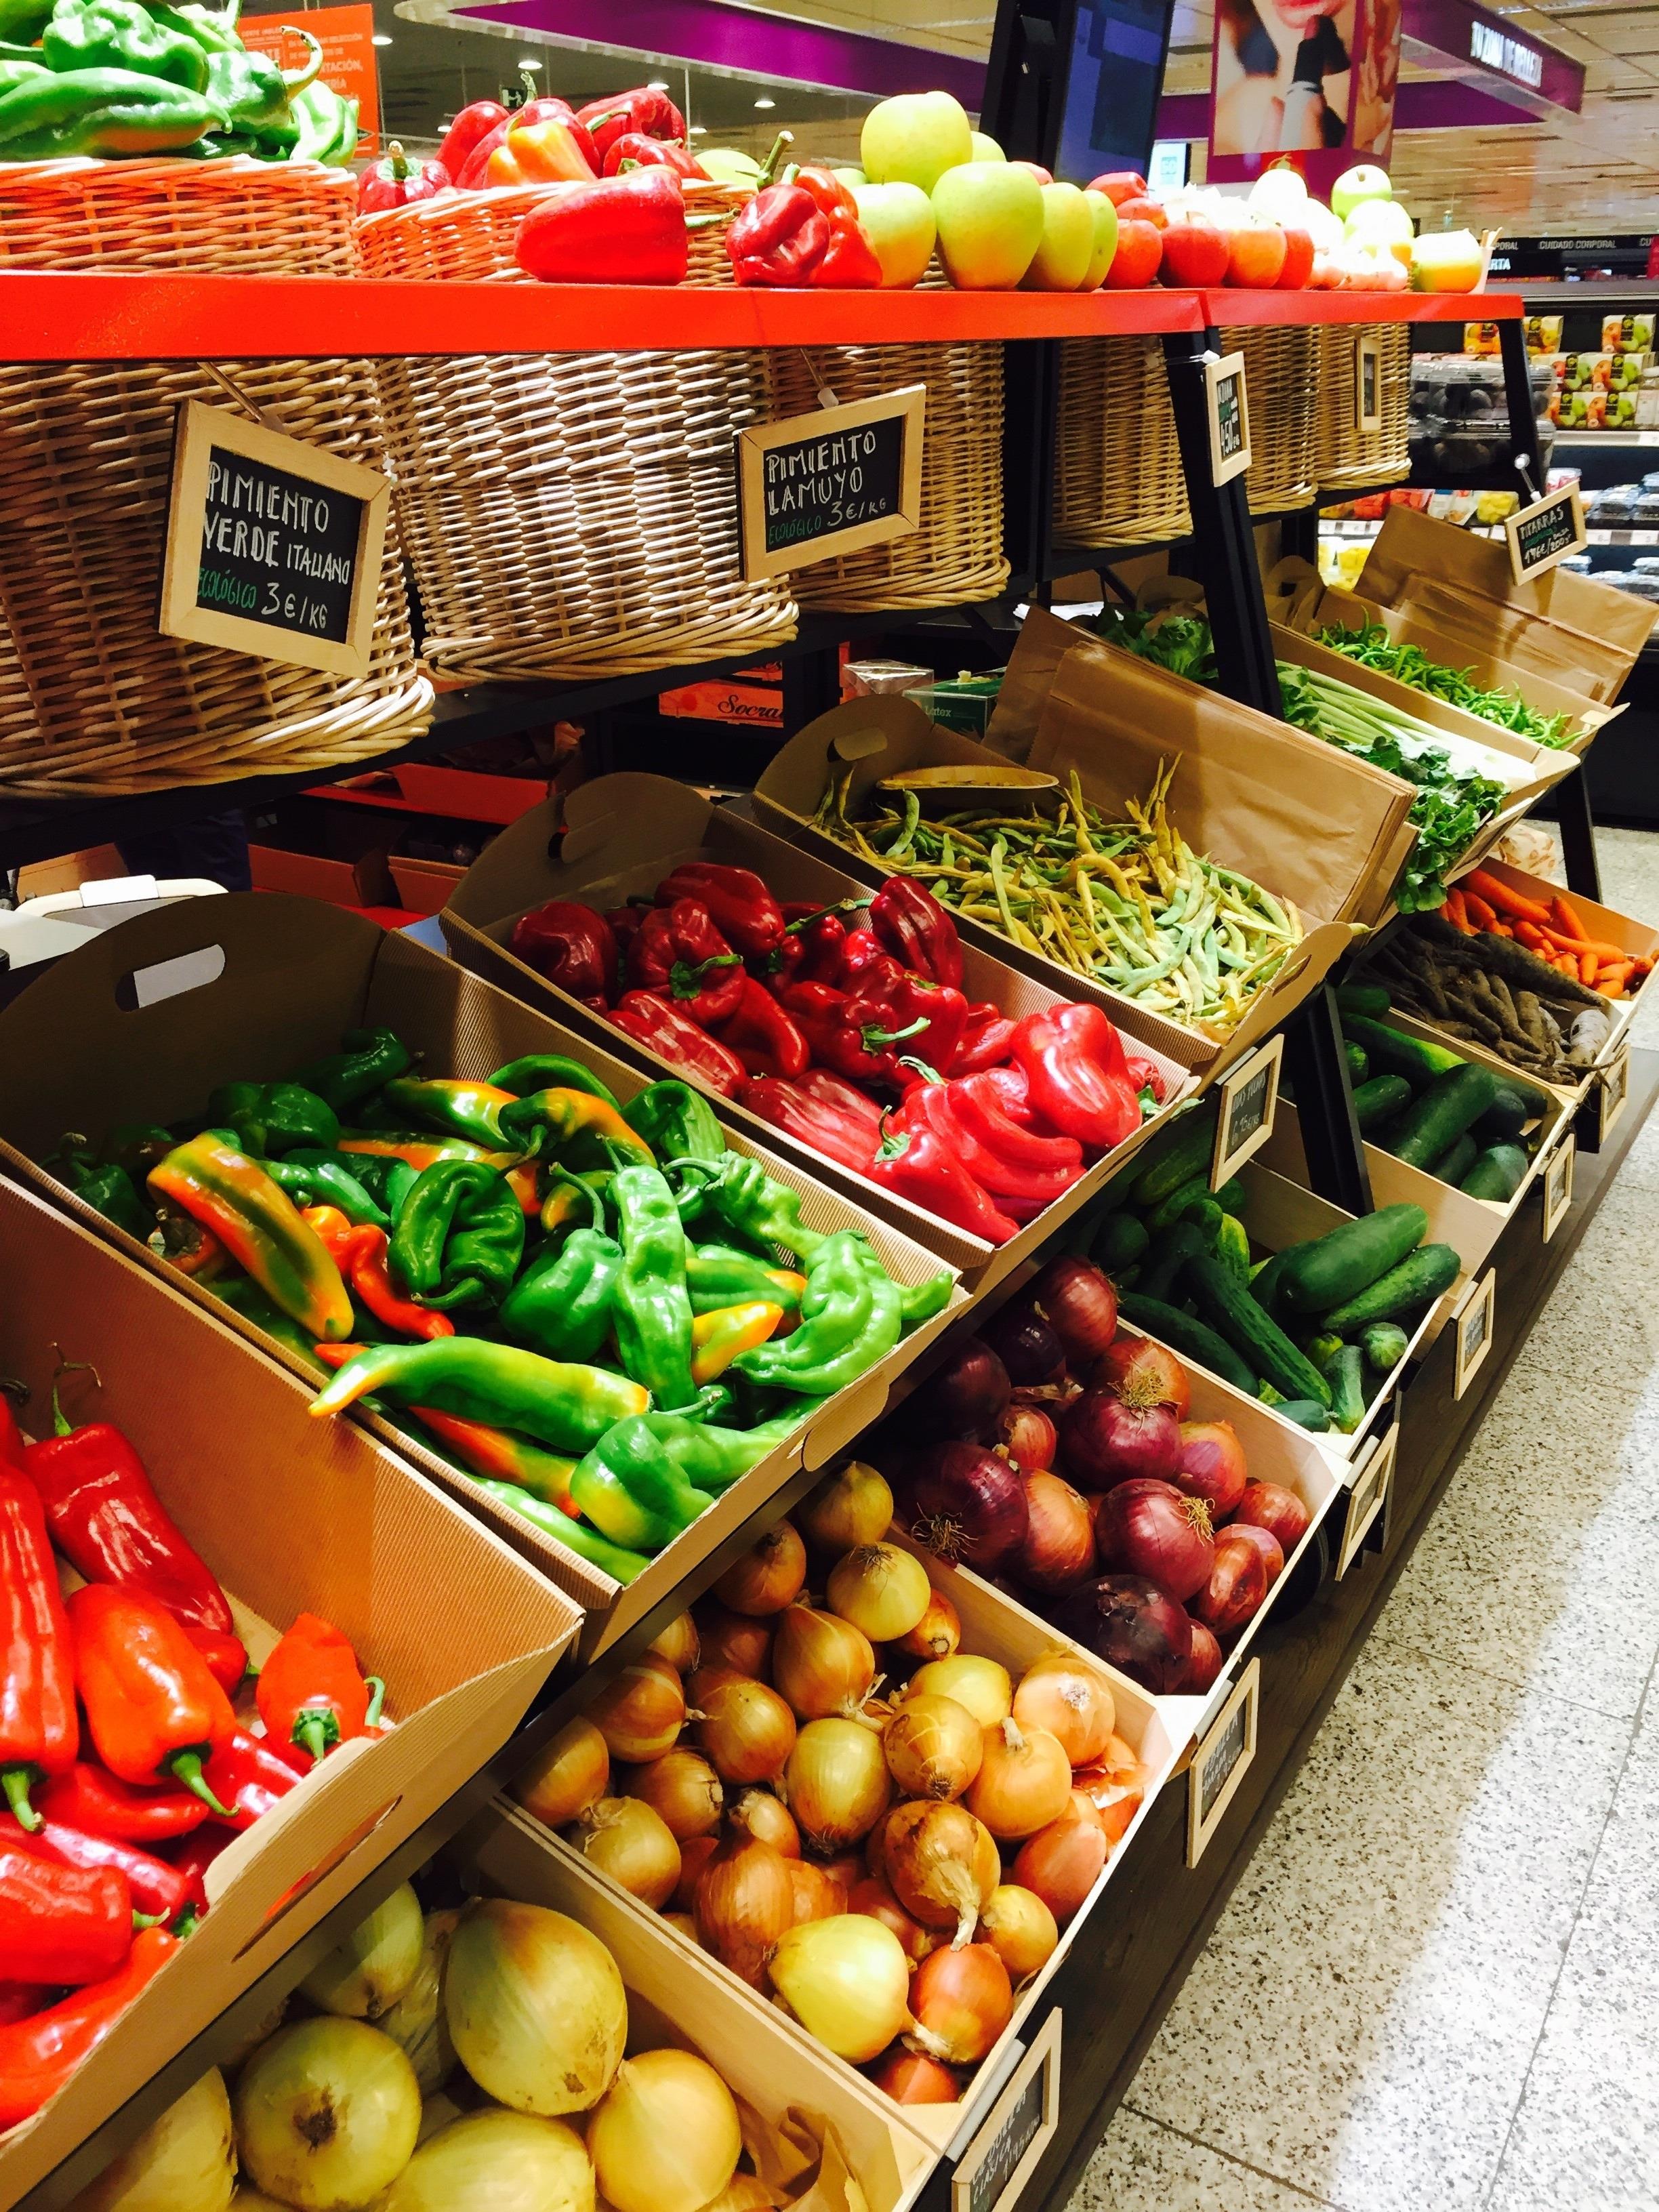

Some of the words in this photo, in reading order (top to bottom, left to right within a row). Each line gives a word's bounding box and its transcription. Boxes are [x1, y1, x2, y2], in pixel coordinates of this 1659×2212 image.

[1539, 240, 1574, 249] CUIDADO
[1575, 239, 1617, 249] CORPORAL
[766, 430, 876, 483] PIMIENTO
[205, 461, 329, 533] PIMIENTO
[767, 466, 863, 516] LAMUYO
[203, 511, 279, 568] VERDE
[287, 543, 350, 586] ITALIANO
